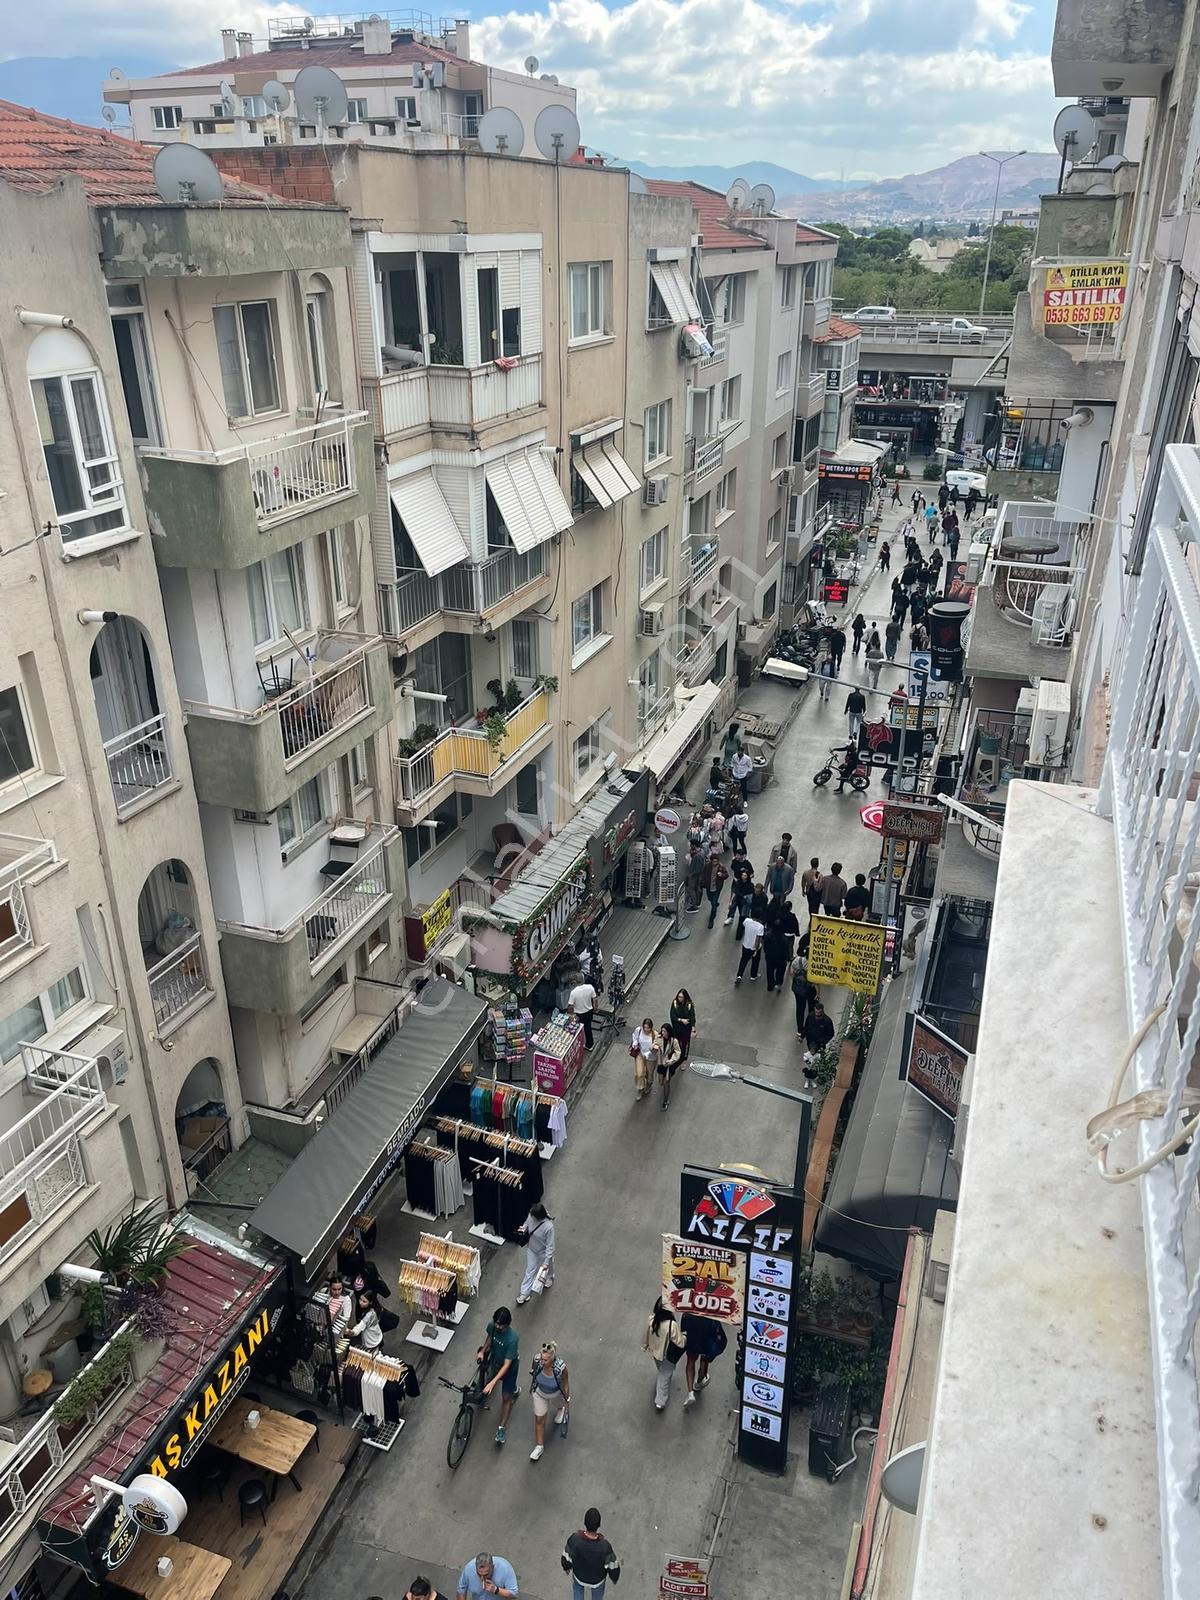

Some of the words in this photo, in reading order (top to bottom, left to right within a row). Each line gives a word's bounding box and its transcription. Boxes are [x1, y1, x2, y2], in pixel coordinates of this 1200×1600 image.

[1070, 267, 1099, 277] ATİLLA
[1101, 265, 1124, 275] KAYA
[1072, 278, 1101, 288] EMLAK
[1104, 277, 1121, 286] TAN
[1048, 289, 1121, 306] SATILIK
[1046, 308, 1070, 323] 0533
[1072, 307, 1091, 322] 663
[1093, 306, 1106, 321] 69
[1108, 306, 1121, 320] 73
[826, 464, 844, 473] METRO
[858, 751, 917, 768] COLO
[813, 936, 836, 945] LOREAL
[813, 943, 829, 951] NOTE
[812, 950, 834, 959] PASTEL
[863, 952, 880, 960] ROSE
[811, 957, 830, 965] NIVEA
[811, 963, 838, 973] GARNIER
[811, 969, 840, 980] SOLINGEN
[386, 1097, 425, 1156] BEMRADO
[688, 1214, 792, 1252] KILIF
[703, 1249, 732, 1259] KILIF
[672, 1256, 698, 1277] 2
[699, 1260, 735, 1283] AL
[677, 1289, 694, 1309] 1
[694, 1293, 732, 1313] ÖDE
[749, 1333, 784, 1350] KILIF
[150, 1433, 183, 1479] AŞ
[184, 1308, 270, 1441] KAZANI
[665, 1582, 687, 1591] ADET
